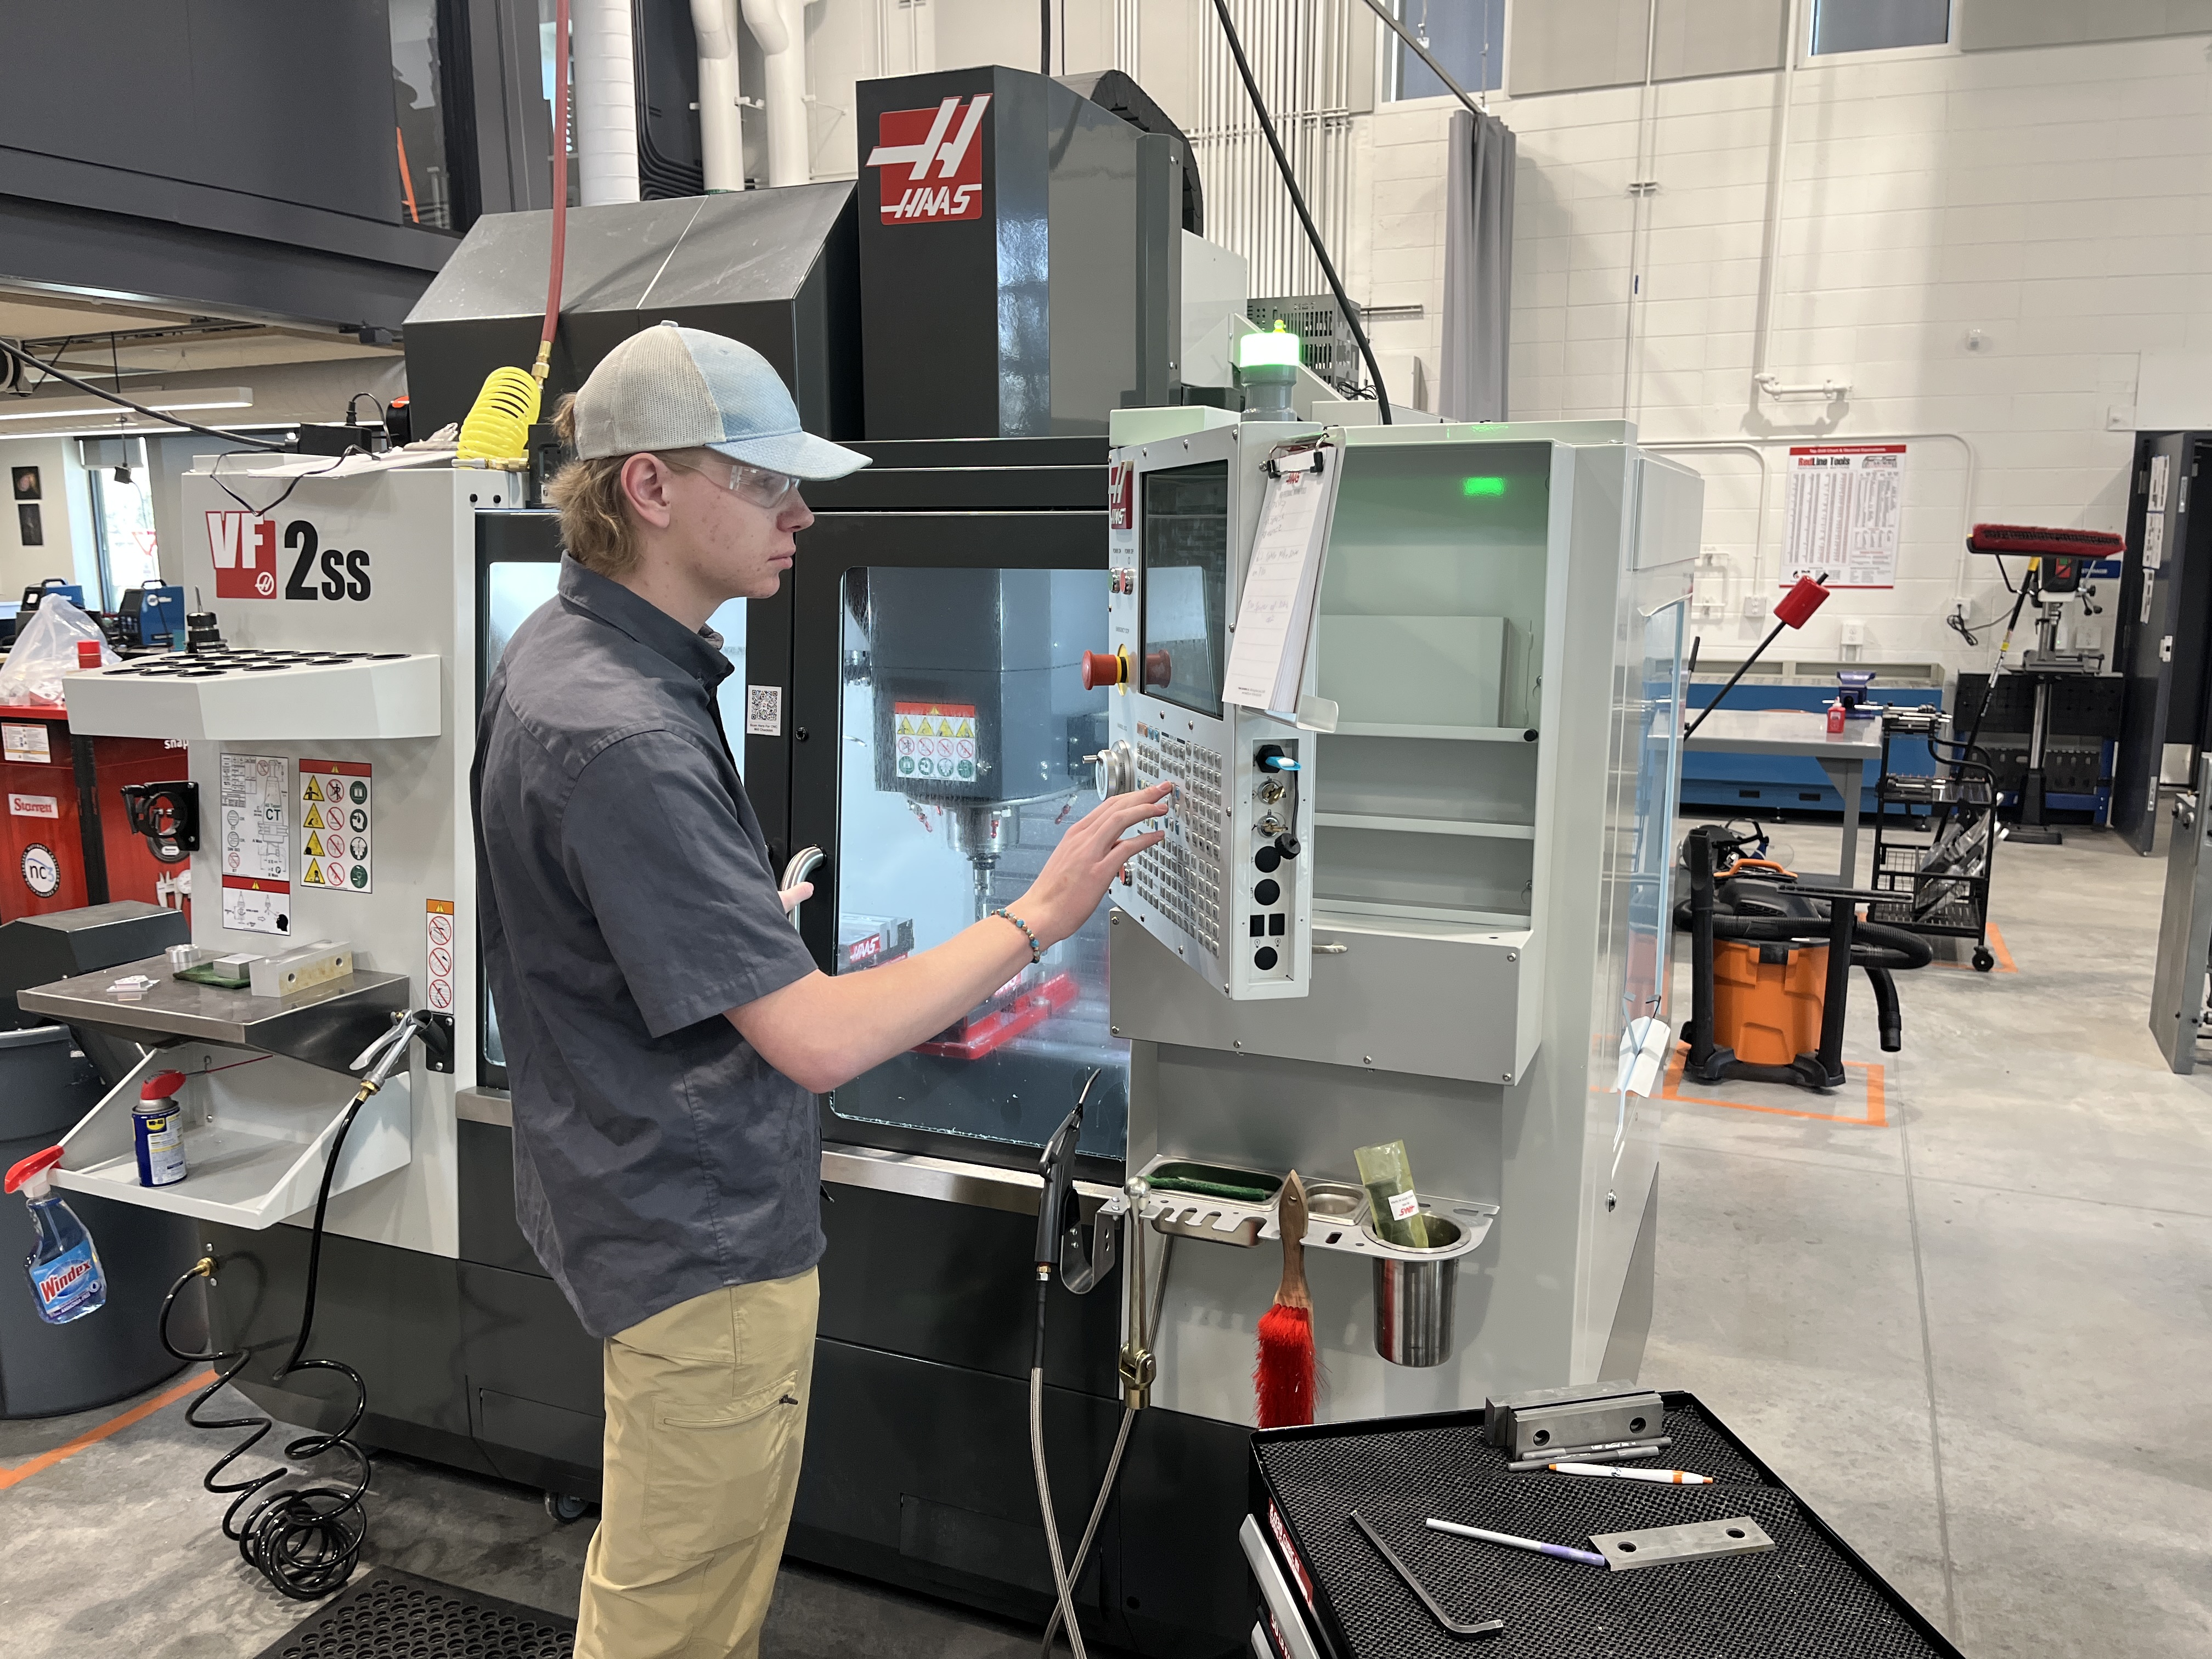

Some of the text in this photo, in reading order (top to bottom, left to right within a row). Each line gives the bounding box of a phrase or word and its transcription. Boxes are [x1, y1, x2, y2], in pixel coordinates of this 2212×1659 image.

[881, 183, 982, 218] HAAS
[1830, 456, 1850, 465] Tools
[206, 512, 264, 568] VF
[266, 808, 281, 821] CT
[850, 936, 880, 960] HAAS
[40, 1261, 91, 1303] Windex
